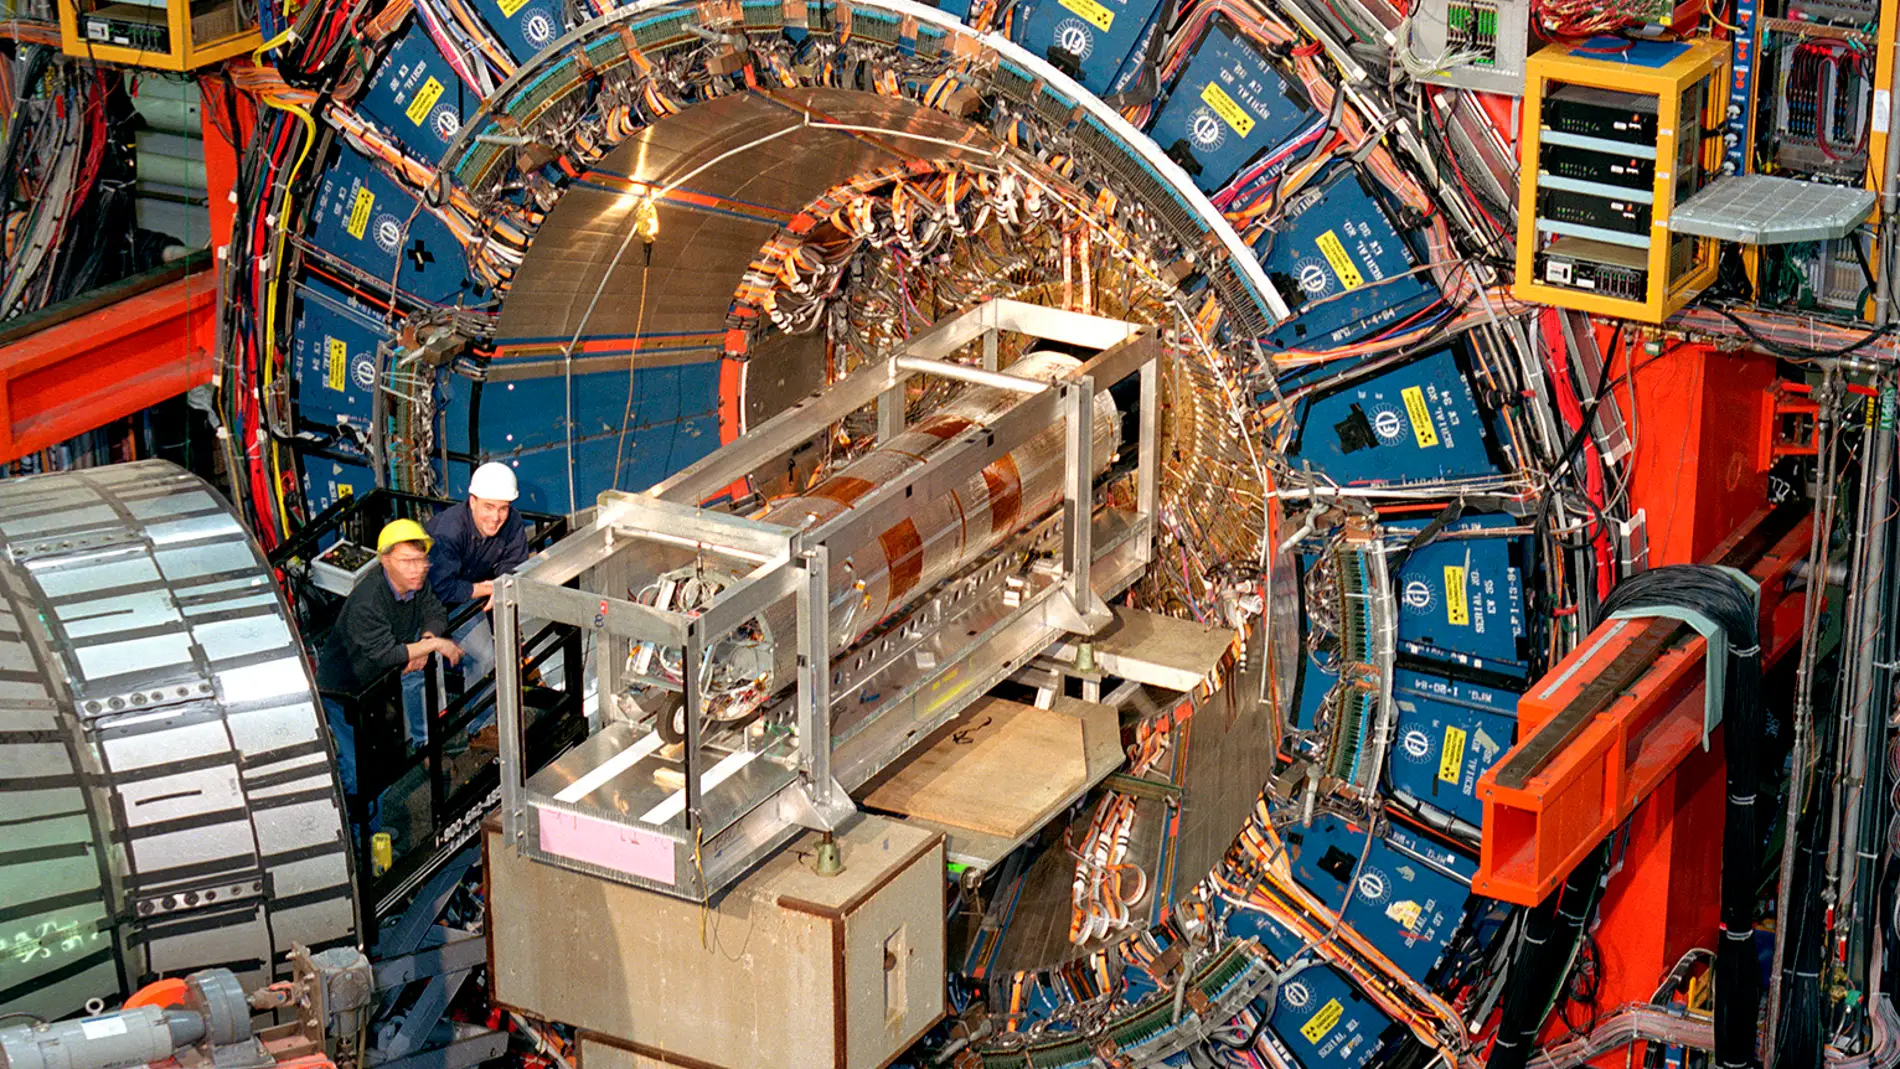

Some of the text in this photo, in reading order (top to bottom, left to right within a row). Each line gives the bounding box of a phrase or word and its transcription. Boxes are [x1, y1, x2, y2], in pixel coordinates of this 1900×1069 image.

[406, 61, 427, 90] SERIAL
[1237, 84, 1270, 120] SERIAL
[345, 177, 361, 212] SERIAL
[1357, 240, 1384, 281] SERIAL
[1435, 406, 1454, 449] SERIAL
[1473, 592, 1485, 634] SERIAL
[1463, 759, 1478, 796] SERIAL
[1318, 1032, 1346, 1058] SERIAL
